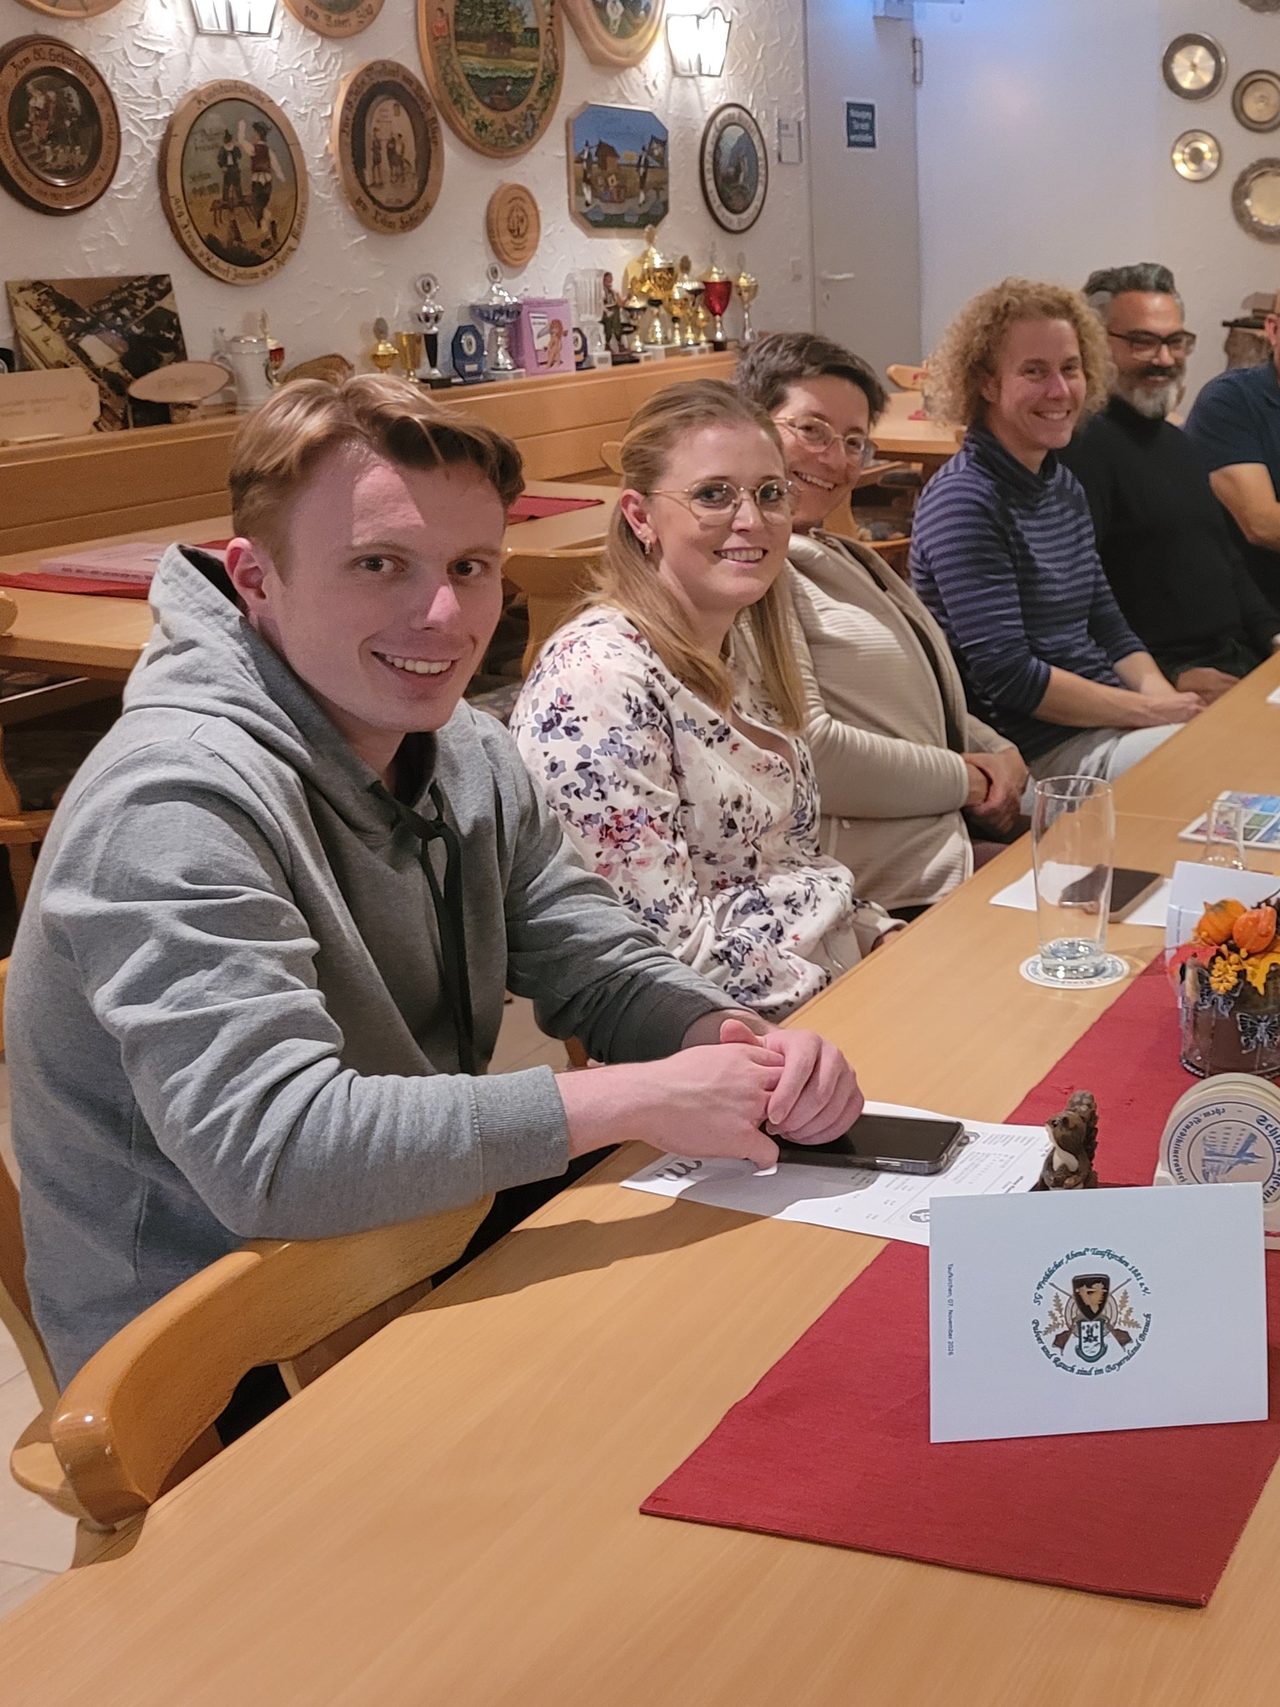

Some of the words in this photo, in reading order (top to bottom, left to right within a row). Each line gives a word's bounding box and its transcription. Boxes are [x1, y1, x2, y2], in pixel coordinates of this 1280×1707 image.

[1033, 1292, 1044, 1306] SG
[1031, 1318, 1045, 1345] Pulver
[1040, 1345, 1057, 1360] und
